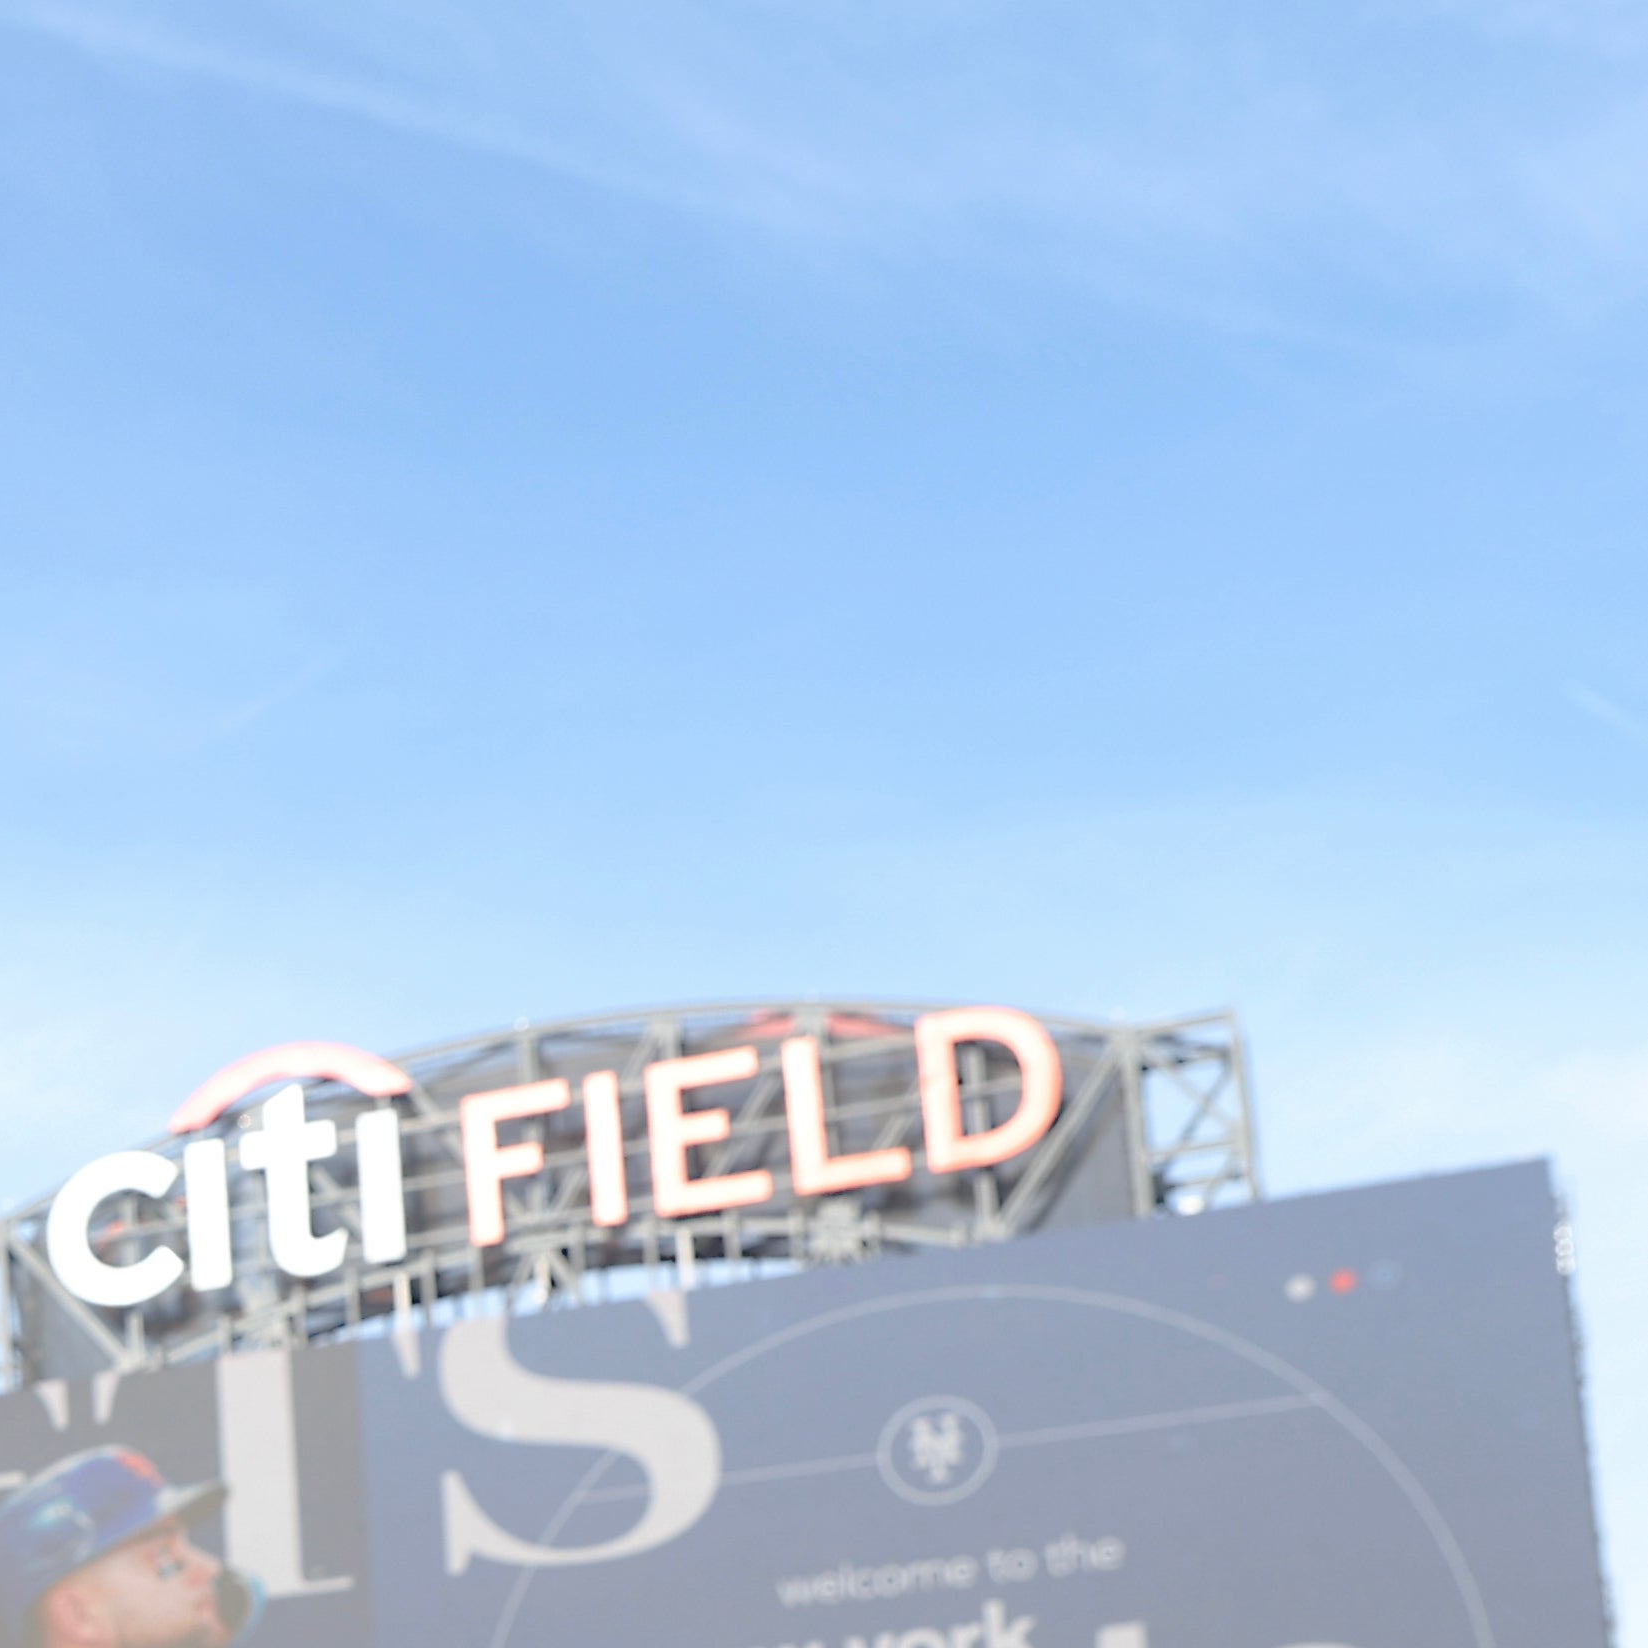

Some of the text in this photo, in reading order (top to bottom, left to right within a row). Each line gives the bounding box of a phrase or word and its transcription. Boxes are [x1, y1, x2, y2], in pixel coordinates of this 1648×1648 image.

[45, 1004, 1064, 1307] citi FIELD
[777, 1529, 1125, 1608] welcome to the
